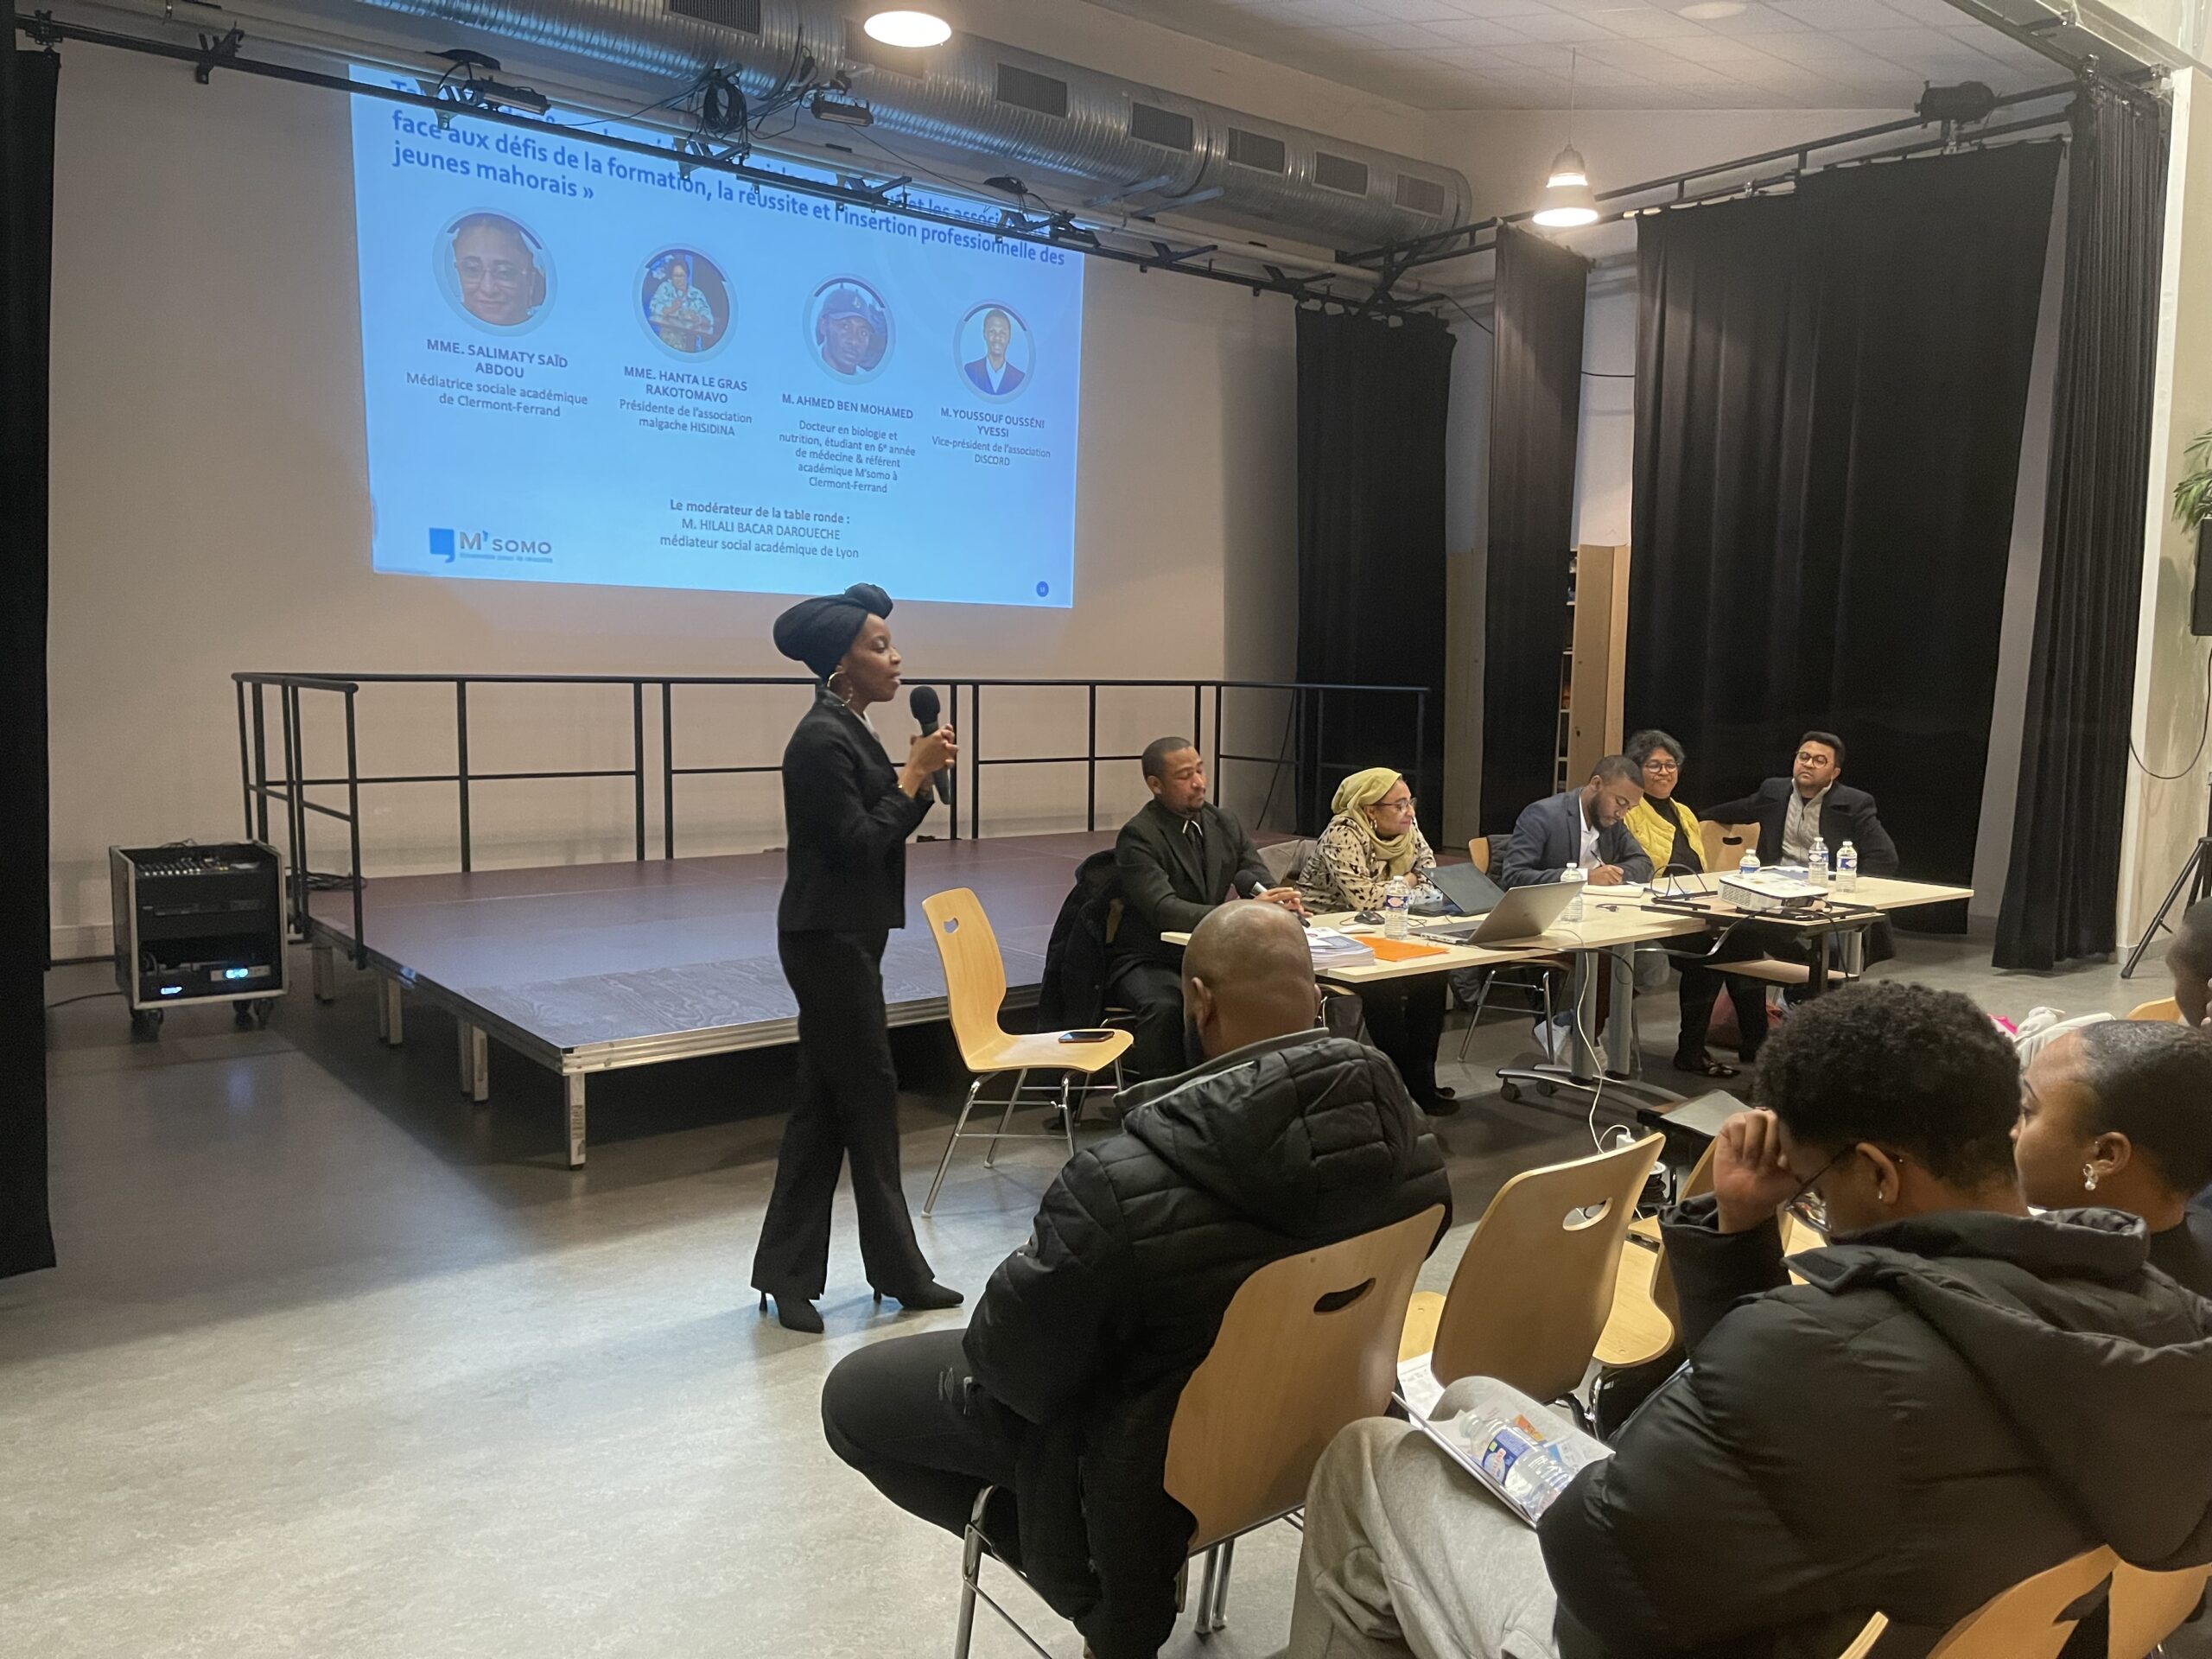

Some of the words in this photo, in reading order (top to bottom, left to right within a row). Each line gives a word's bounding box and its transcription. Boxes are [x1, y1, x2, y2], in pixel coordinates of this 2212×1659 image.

[391, 140, 470, 175] jeunes
[477, 162, 577, 198] mahorais
[392, 109, 442, 139] face
[448, 127, 488, 150] aux
[496, 133, 547, 162] défis
[554, 144, 578, 169] de
[585, 151, 602, 175] la
[608, 156, 712, 201] formation,
[718, 181, 734, 200] la
[739, 184, 808, 216] réussite
[813, 203, 830, 220] et
[921, 227, 1036, 261] professionnelle
[1039, 246, 1065, 265] des
[426, 339, 465, 355] MME.
[468, 344, 535, 364] SALIMATY
[537, 353, 568, 368] SAÏD
[475, 361, 524, 378] ABDOU
[624, 365, 656, 380] MME.
[659, 370, 699, 385] HANTA
[702, 376, 715, 387] LE
[717, 378, 747, 391] GRAS
[406, 372, 474, 391] Médiatrice
[476, 383, 517, 396] sociale
[519, 387, 588, 405] académique
[645, 384, 728, 404] RAKOTOMAVO
[439, 392, 454, 405] de
[457, 395, 561, 416] Clermont-Ferrand
[620, 398, 675, 415] Présidente
[677, 405, 690, 416] de
[693, 407, 753, 424] l'association
[782, 393, 794, 405] M.
[797, 396, 835, 410] AHMED
[837, 400, 858, 412] BEN
[861, 404, 913, 419] MOHAMED
[639, 417, 688, 431] malgache
[952, 409, 1003, 424] YOUSSOUF
[799, 420, 836, 434] Docteur
[838, 426, 849, 435] en
[851, 425, 887, 441] biologie
[888, 430, 898, 441] et
[977, 425, 1009, 438] YVESSI
[779, 433, 822, 447] nutrition,
[825, 436, 862, 450] étudiant
[865, 442, 875, 452] en
[889, 445, 916, 456] année
[931, 435, 990, 452] Vice-président
[993, 443, 1002, 454] de
[1004, 443, 1051, 458] l'association
[796, 448, 807, 458] de
[810, 448, 853, 463] médecine
[856, 454, 863, 464] &
[865, 454, 900, 467] référent
[798, 462, 853, 477] académique
[855, 467, 891, 480] M'somo
[893, 470, 898, 480] à
[809, 476, 887, 493] Clermont-Ferrand
[670, 499, 683, 512] Le
[686, 500, 753, 517] modérateur
[755, 506, 769, 518] de
[772, 507, 781, 518] la
[784, 509, 811, 522] table
[813, 512, 844, 524] ronde
[682, 518, 696, 530] M.
[700, 519, 734, 532] HILALI
[737, 522, 773, 536] BACAR
[776, 525, 841, 540] DAROUECHE
[660, 534, 719, 550] médiateur
[721, 538, 752, 552] social
[754, 541, 817, 557] académique
[820, 545, 834, 557] de
[836, 547, 859, 560] Lyon
